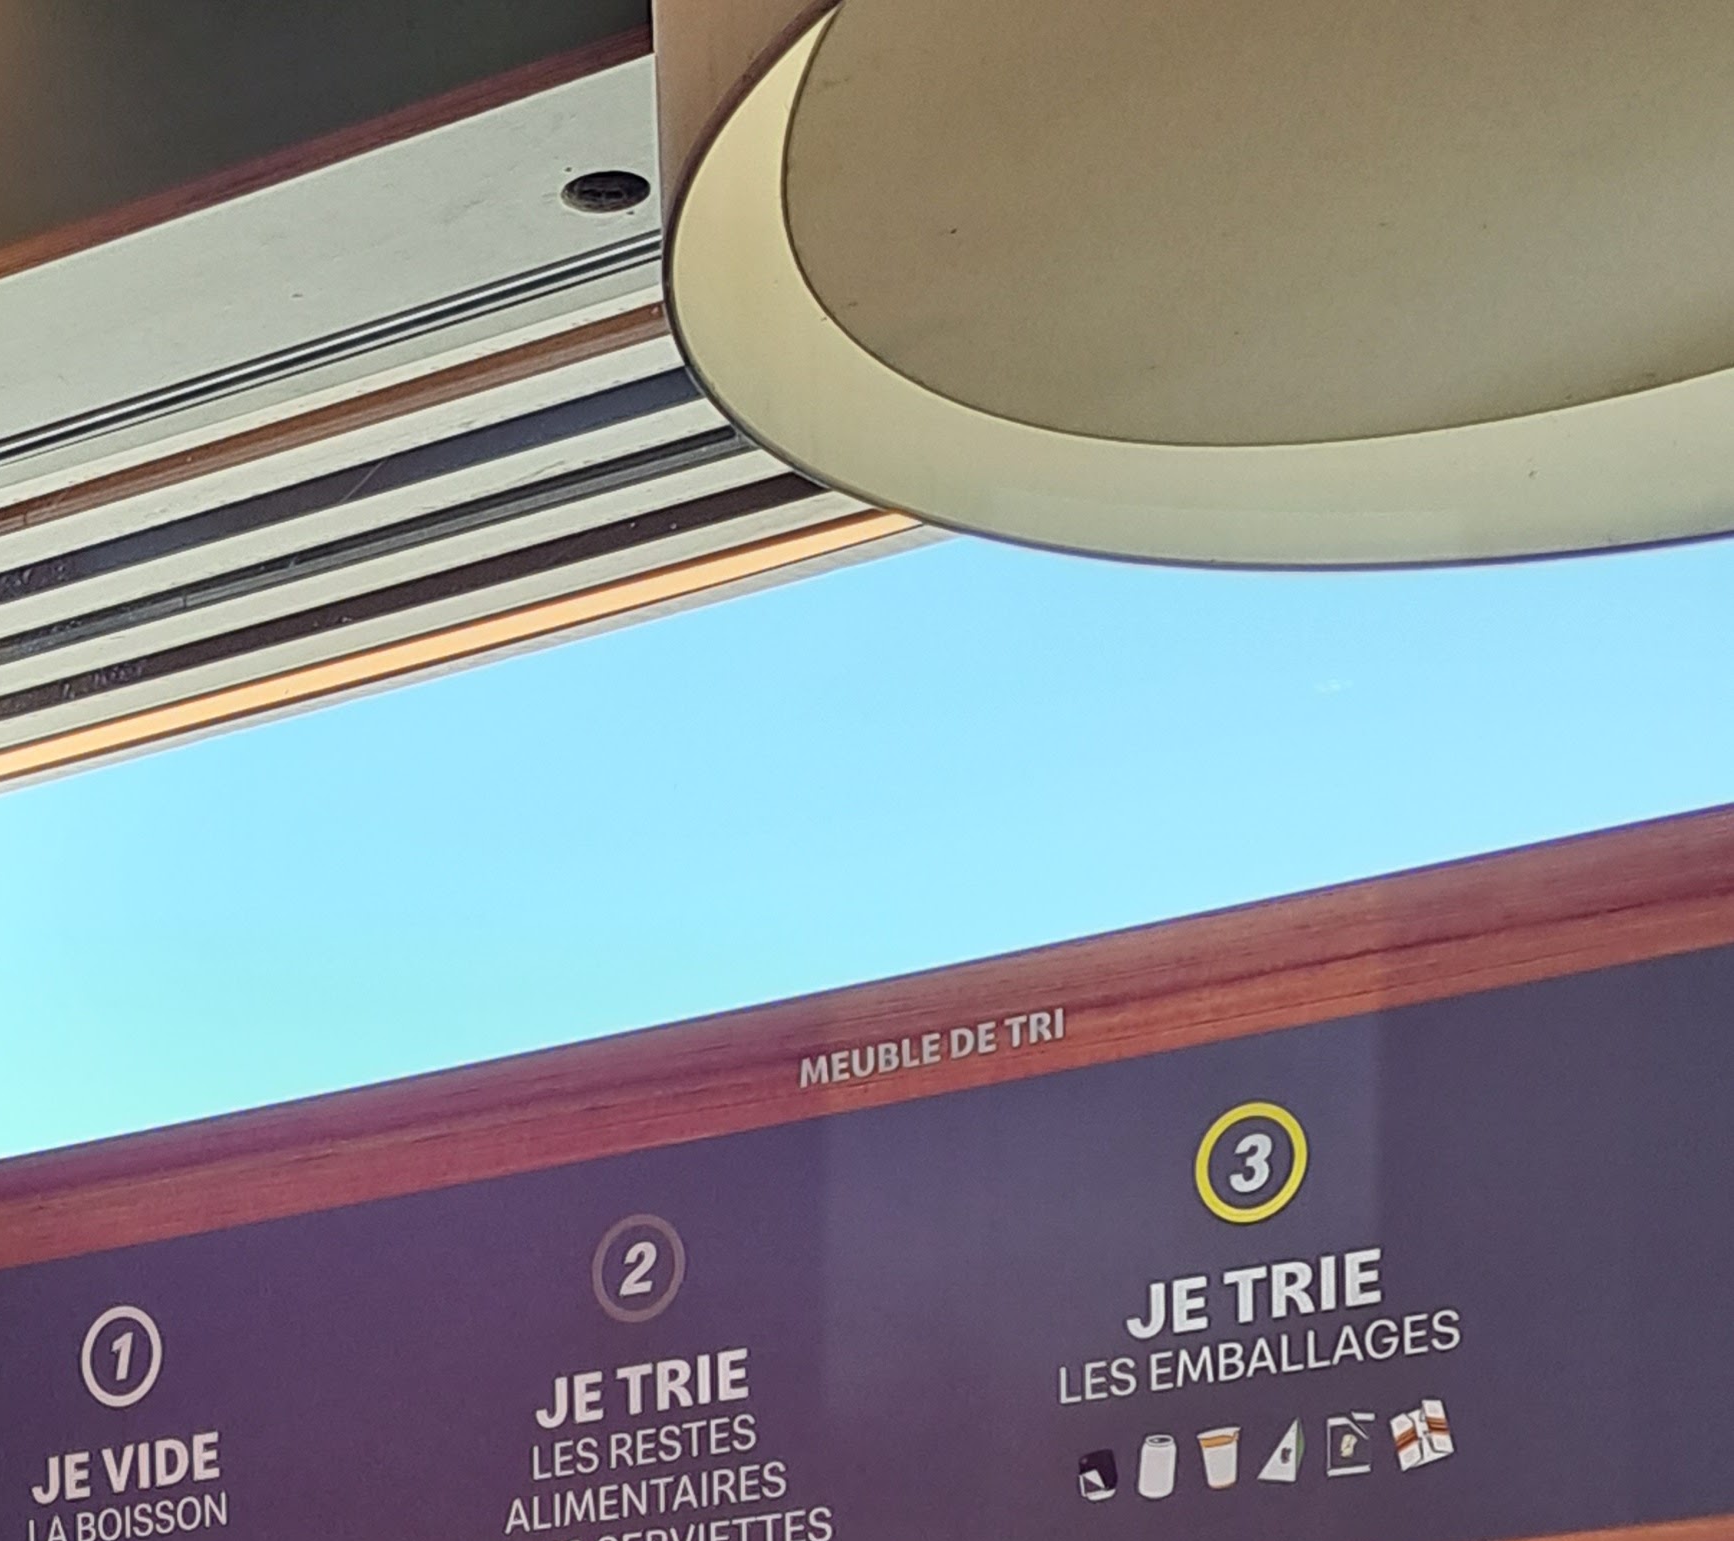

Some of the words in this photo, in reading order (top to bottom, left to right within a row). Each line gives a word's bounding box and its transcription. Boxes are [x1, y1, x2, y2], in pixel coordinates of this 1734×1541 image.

[799, 1033, 941, 1088] MEUBLE
[950, 1021, 998, 1060] DE
[1004, 1007, 1064, 1049] TRI
[1229, 1133, 1273, 1193] 3
[619, 1241, 657, 1297] 2
[1126, 1275, 1209, 1340] JE
[1222, 1247, 1383, 1325] TRIE
[110, 1331, 134, 1381] 1
[534, 1370, 604, 1429] JE
[616, 1347, 749, 1416] TRIE
[1059, 1357, 1137, 1405] LES
[1150, 1309, 1462, 1392] EMBALLAGES
[31, 1451, 91, 1506] JE
[101, 1430, 221, 1494] VIDE
[531, 1437, 600, 1481] LES
[609, 1413, 757, 1470] RESTES
[504, 1460, 788, 1535] ALIMENTAIRES
